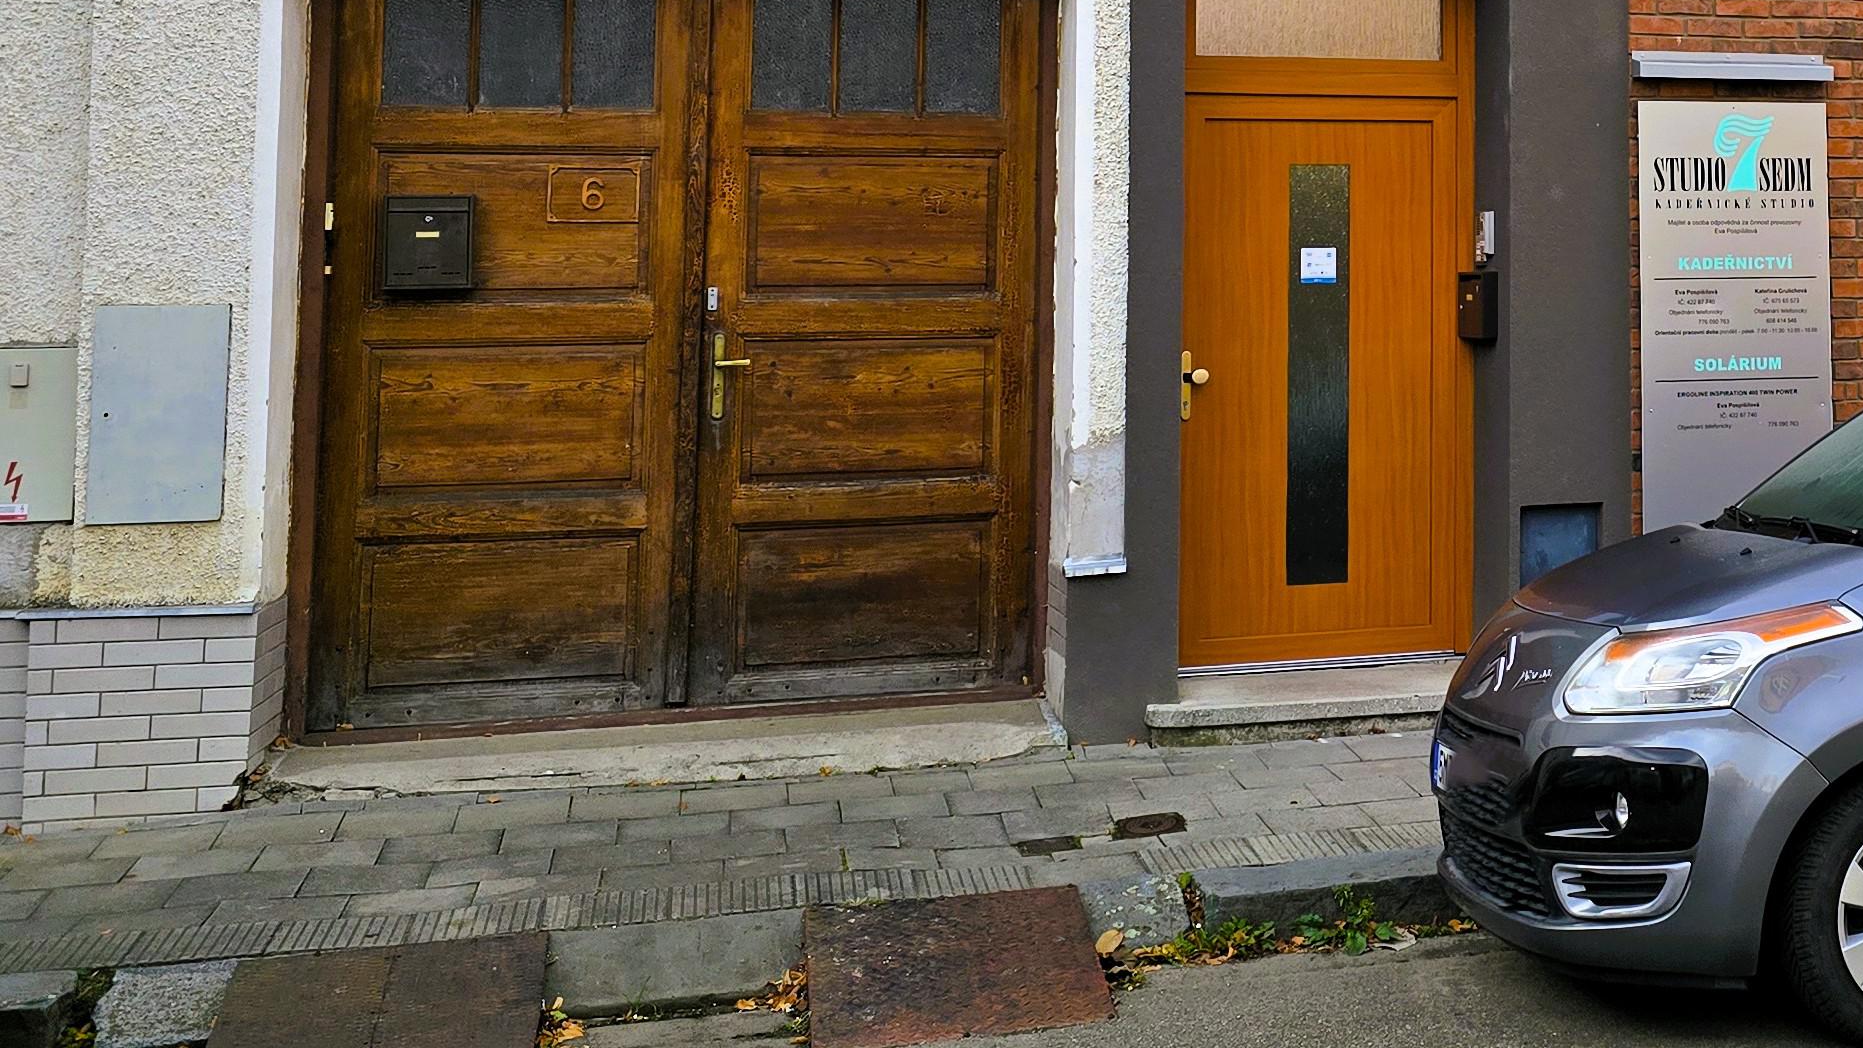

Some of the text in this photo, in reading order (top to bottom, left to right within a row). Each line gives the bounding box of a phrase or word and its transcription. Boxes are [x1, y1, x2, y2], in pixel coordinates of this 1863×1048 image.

[1653, 113, 1812, 192] STUDIO 7 SEDM
[582, 177, 605, 210] 6
[1655, 197, 1815, 209] KADEŘNICKÉ STUDIO
[1678, 253, 1793, 271] KADEŘNICTVÍ
[1694, 355, 1783, 372] SOLÁRIUM
